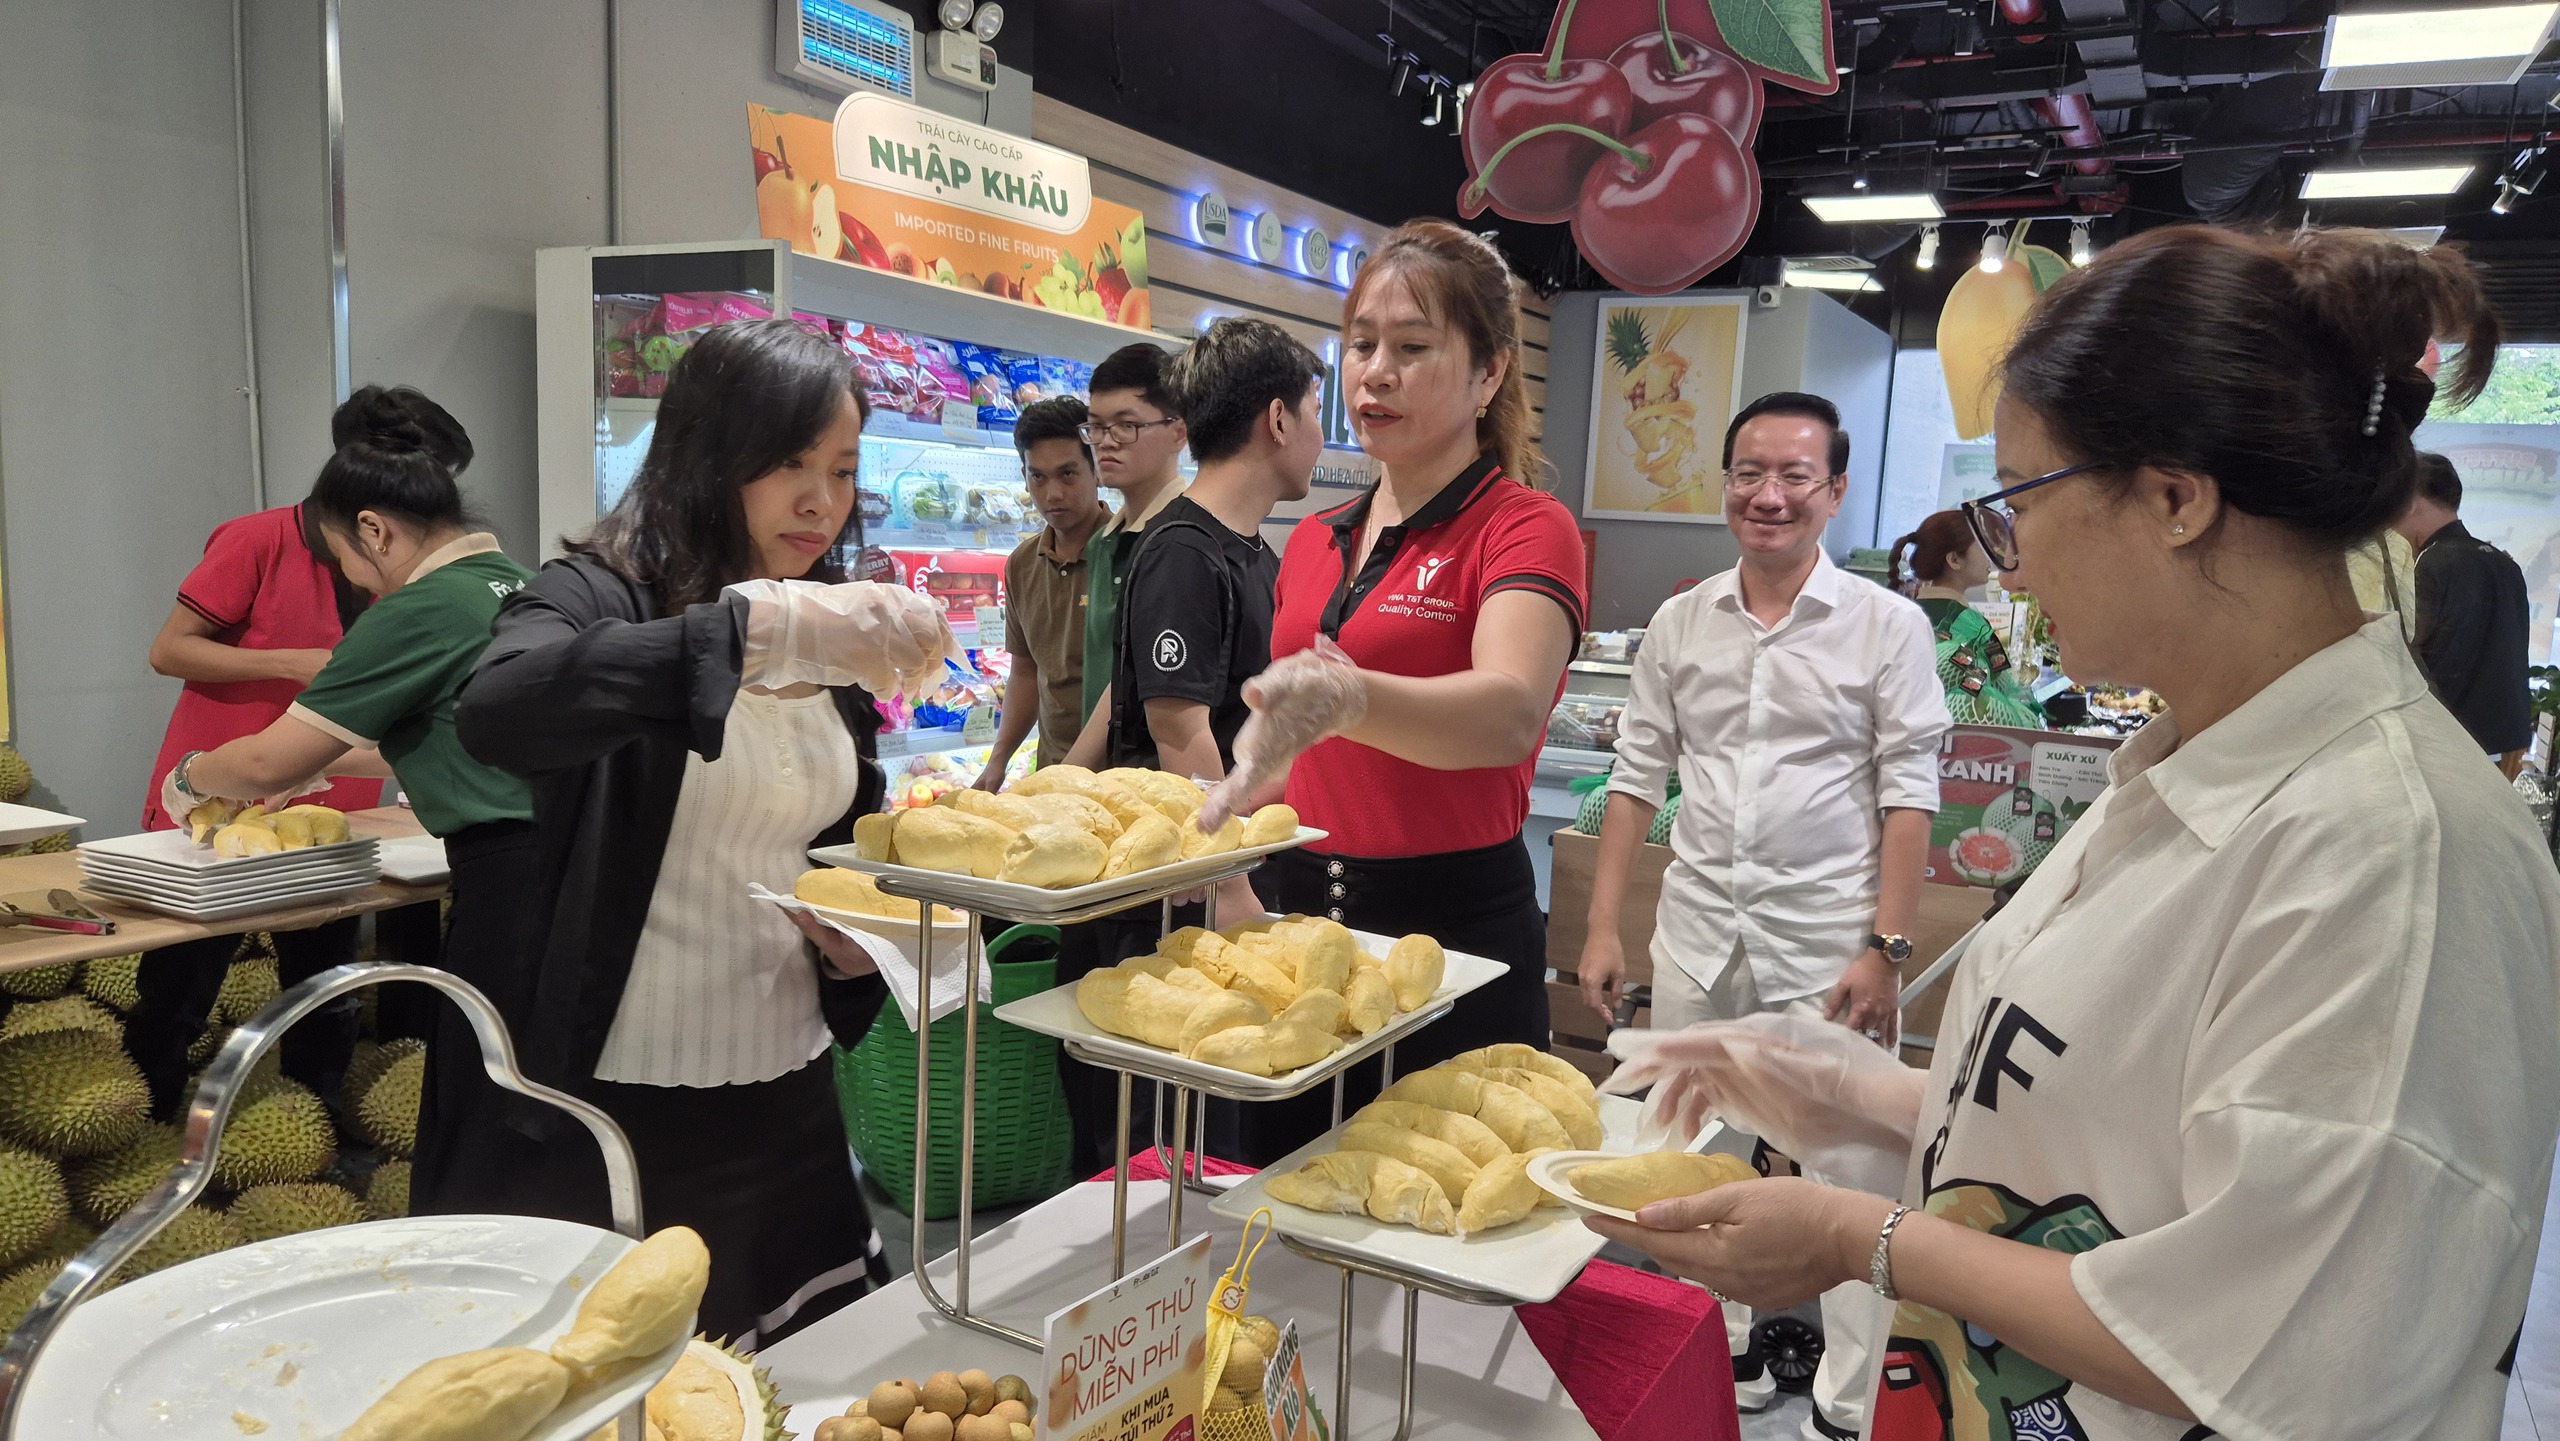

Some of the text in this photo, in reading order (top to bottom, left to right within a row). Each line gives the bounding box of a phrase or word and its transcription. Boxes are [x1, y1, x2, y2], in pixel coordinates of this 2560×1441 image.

[917, 121, 1023, 162] TRÁI CÂY CAO CẤP
[868, 135, 1069, 217] NHẬP KHẨU
[1204, 201, 1227, 220] USDA
[894, 211, 1060, 264] IMPORTED FINE FRUITS
[1378, 603, 1457, 623] Quality Control
[1406, 594, 1423, 604] T&T
[1423, 595, 1455, 609] GROUP
[2046, 750, 2098, 765] XUẤT XỨ
[1060, 1275, 1197, 1386] DÙNG THỬ
[1072, 1324, 1182, 1421] MIỄN PHÍ
[1121, 1386, 1170, 1429] KHI MUA
[1142, 1407, 1165, 1434] THỨ
[1166, 1402, 1174, 1419] 2
